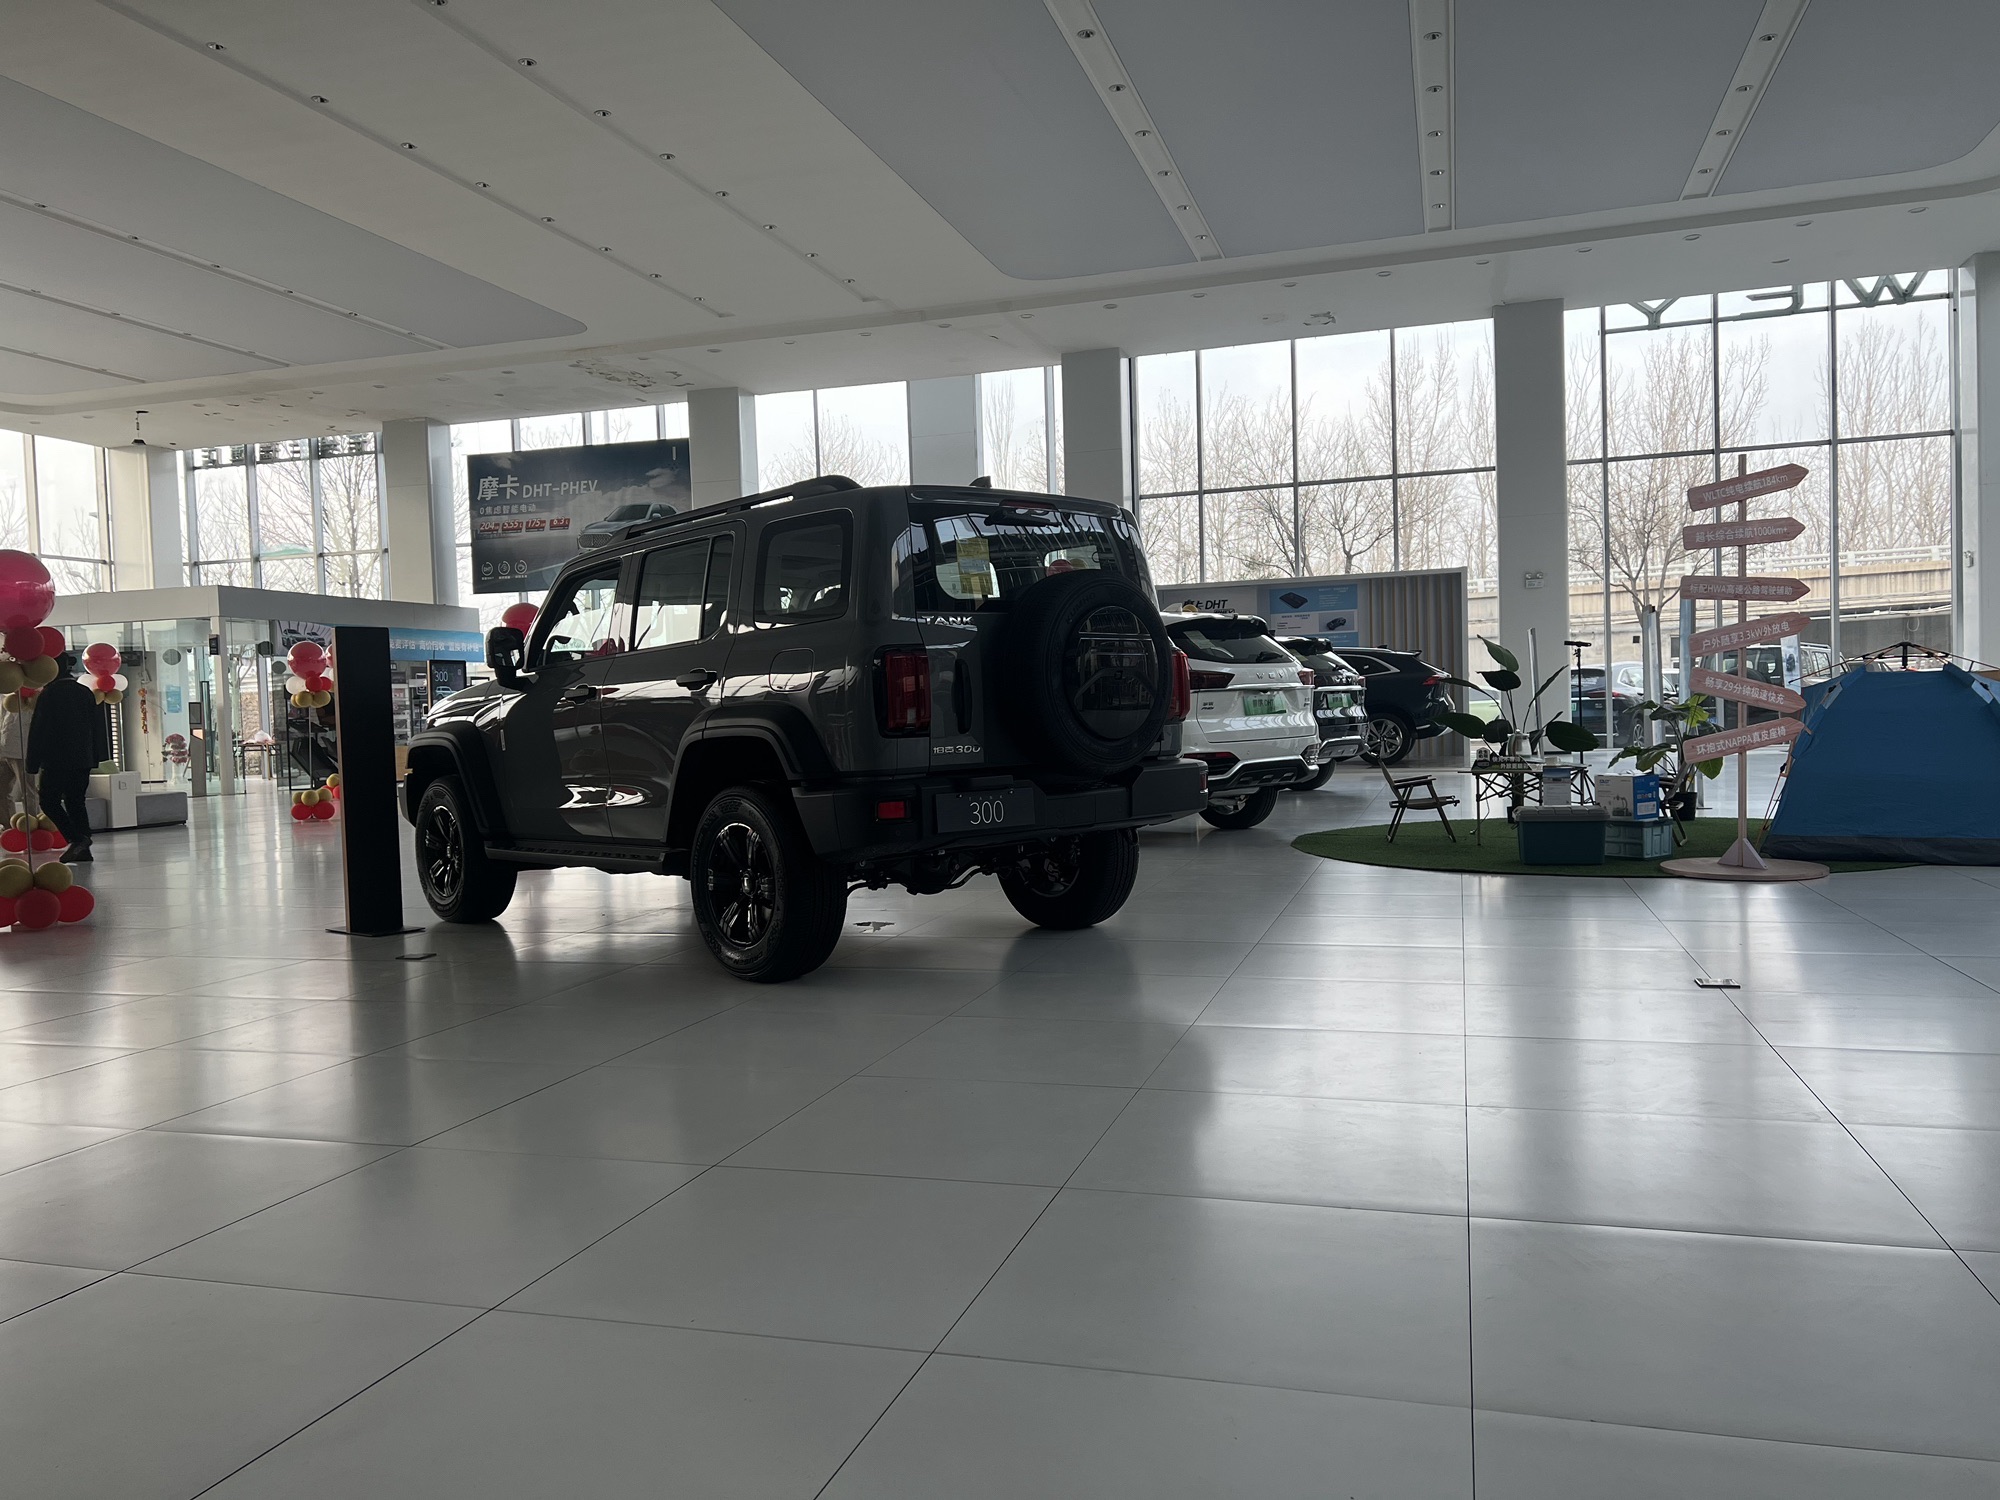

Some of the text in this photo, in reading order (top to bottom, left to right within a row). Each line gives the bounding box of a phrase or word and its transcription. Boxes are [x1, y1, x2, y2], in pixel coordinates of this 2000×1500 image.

[477, 474, 598, 501] 摩卡 DHT-PHEV
[1702, 474, 1789, 502] WLTC纯电续航184km
[479, 503, 537, 515] 0焦虑智能电动
[1695, 526, 1788, 543] 超长综合续航1000km+
[1690, 583, 1793, 596] 标配HWA高速公路驾驶辅助
[1205, 599, 1228, 610] DHT
[921, 615, 974, 625] TANK
[1702, 621, 1790, 651] 户外随享3.3kW外放电
[434, 671, 448, 682] 300
[1704, 676, 1786, 705] 畅享29分钟极速快充
[1696, 726, 1787, 755] 环抱式NAPPA真皮座椅
[969, 800, 1004, 825] 300
